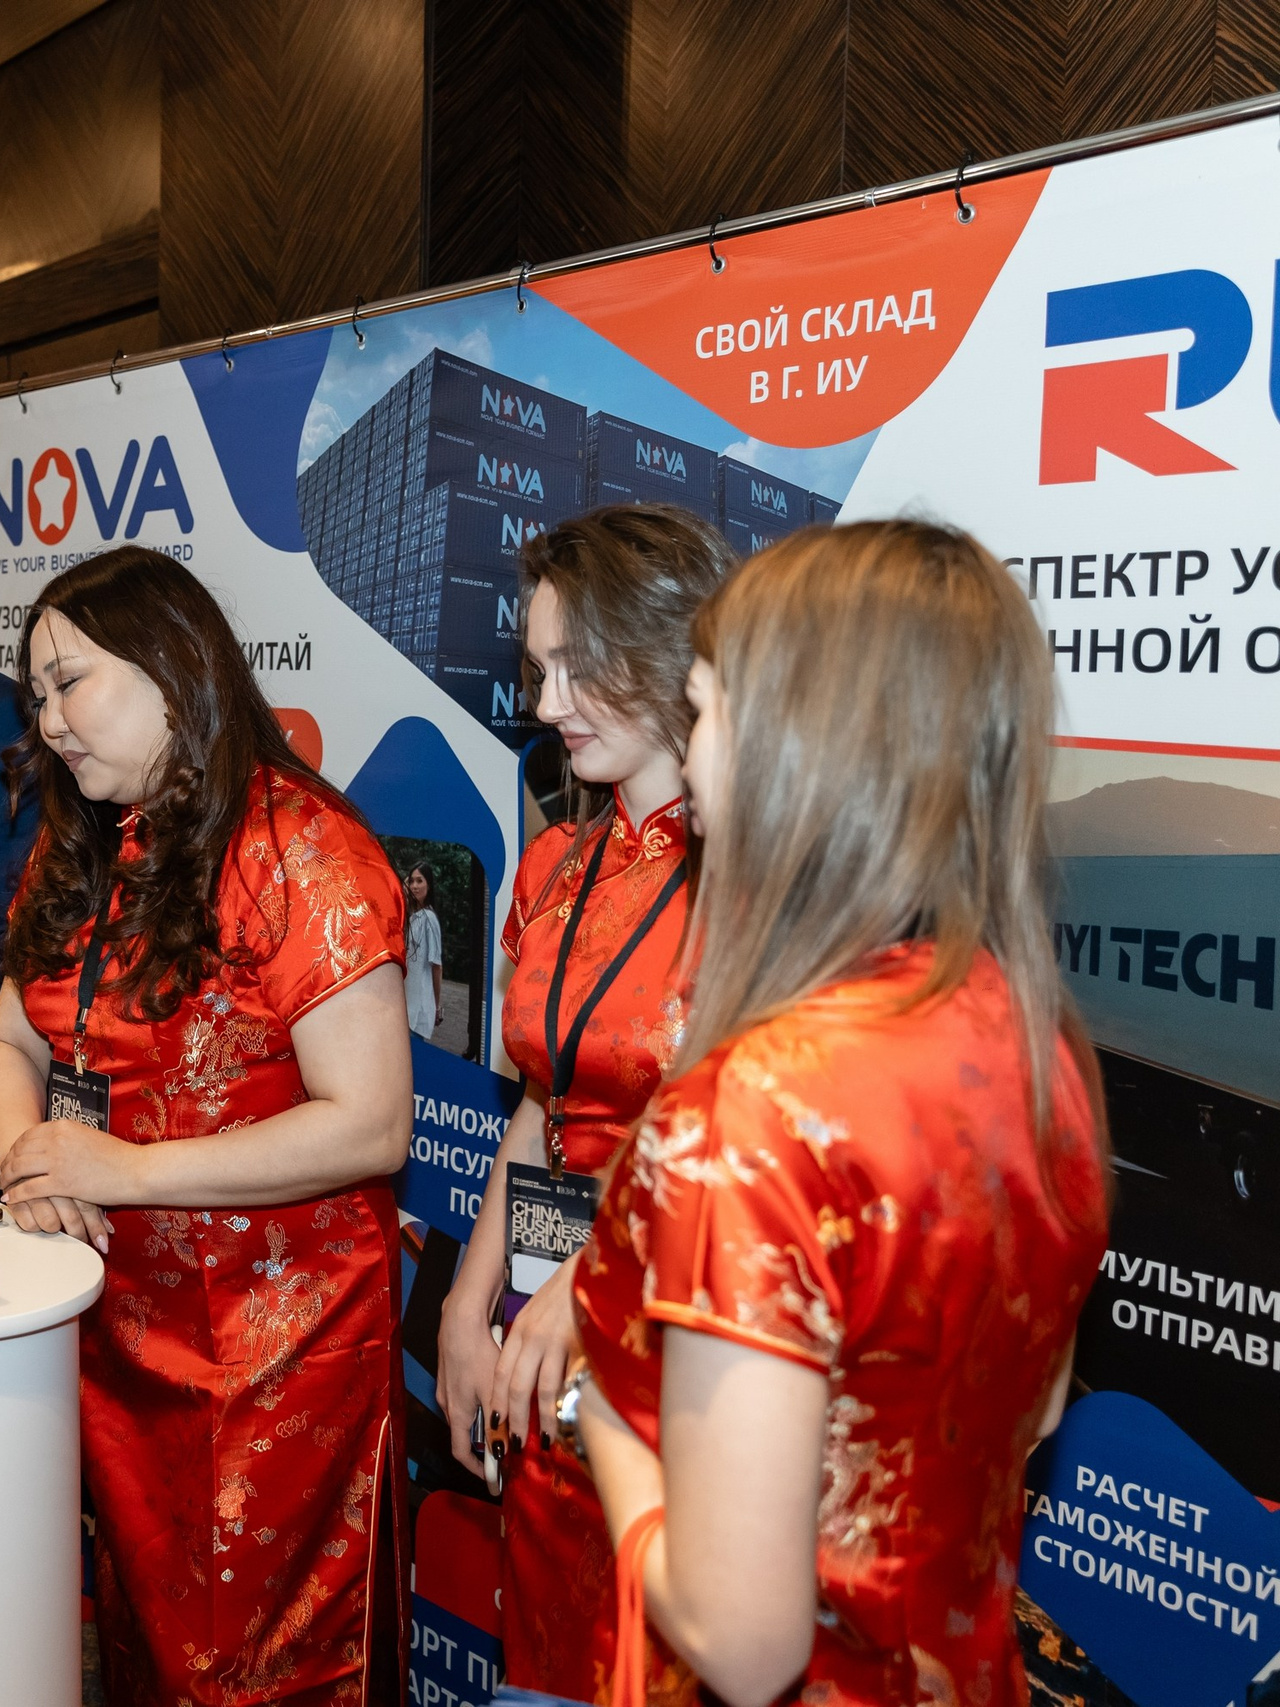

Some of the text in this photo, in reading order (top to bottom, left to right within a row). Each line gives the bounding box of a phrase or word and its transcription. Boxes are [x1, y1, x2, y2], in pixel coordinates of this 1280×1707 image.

[695, 288, 936, 359] СВОЙ СКЛАД
[750, 355, 868, 404] В Г. ИУ
[1039, 259, 1280, 485] R
[13, 556, 45, 573] YOUR
[243, 633, 311, 670] ИТАЙ
[1110, 926, 1276, 1010] TECH
[52, 1093, 82, 1114] CHINA
[52, 1104, 99, 1130] BUSINESS
[512, 1200, 564, 1224] CHINA
[512, 1214, 592, 1244] BUSINESS
[512, 1229, 572, 1255] FORUM
[1112, 1299, 1280, 1373] ОТПРАВ
[1076, 1465, 1210, 1533] РАСЧЕТ
[1023, 1488, 1280, 1606] ТАМОЖЕННОЙ
[1034, 1535, 1258, 1642] СТОИМОСТИ
